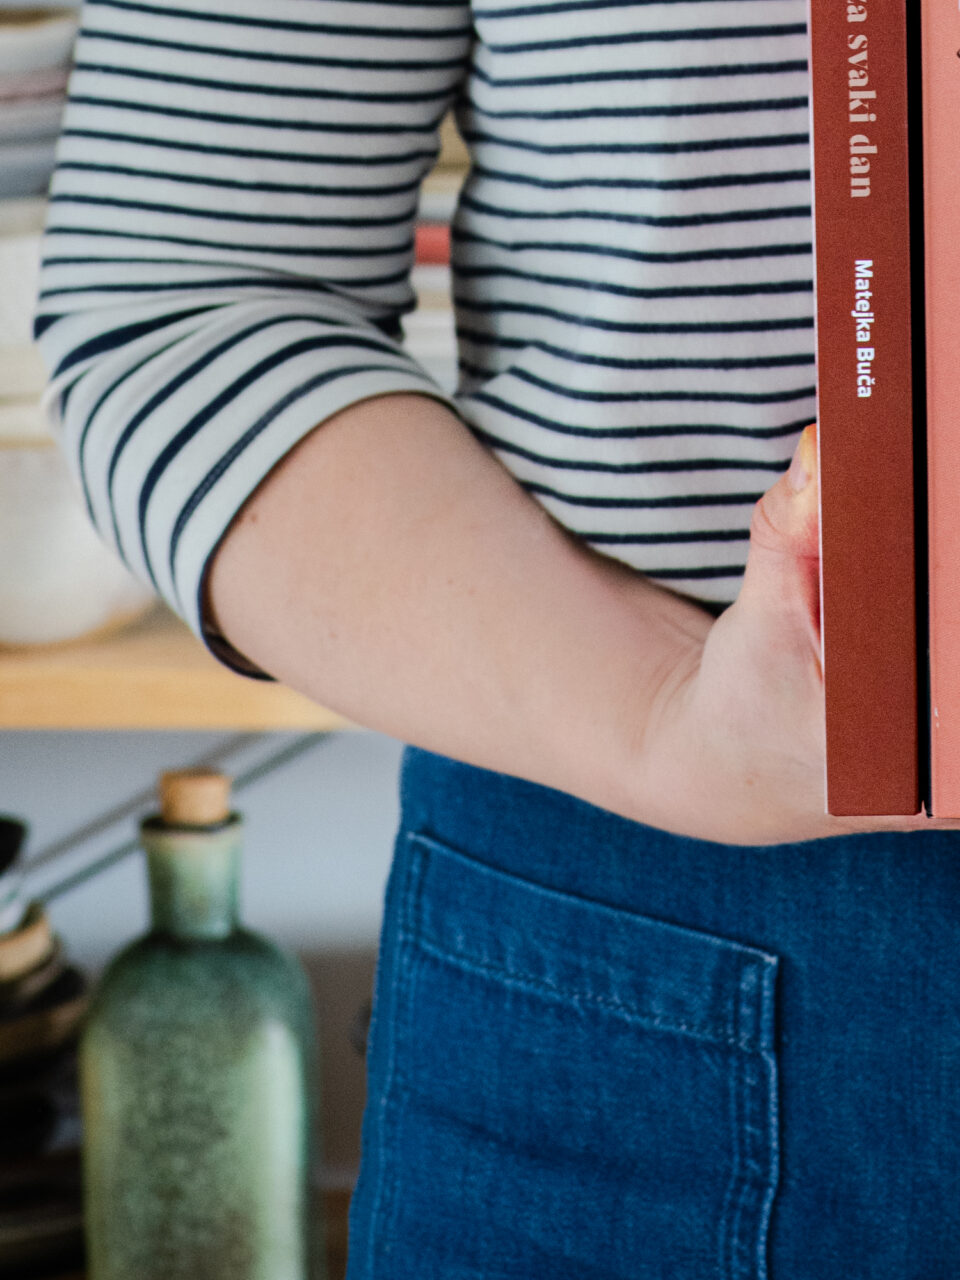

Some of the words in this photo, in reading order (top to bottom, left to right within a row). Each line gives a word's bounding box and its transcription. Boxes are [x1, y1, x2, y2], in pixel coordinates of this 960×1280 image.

[847, 34, 877, 123] svaki
[848, 133, 878, 198] dan
[850, 259, 875, 343] Matejka
[855, 346, 877, 398] Buča
